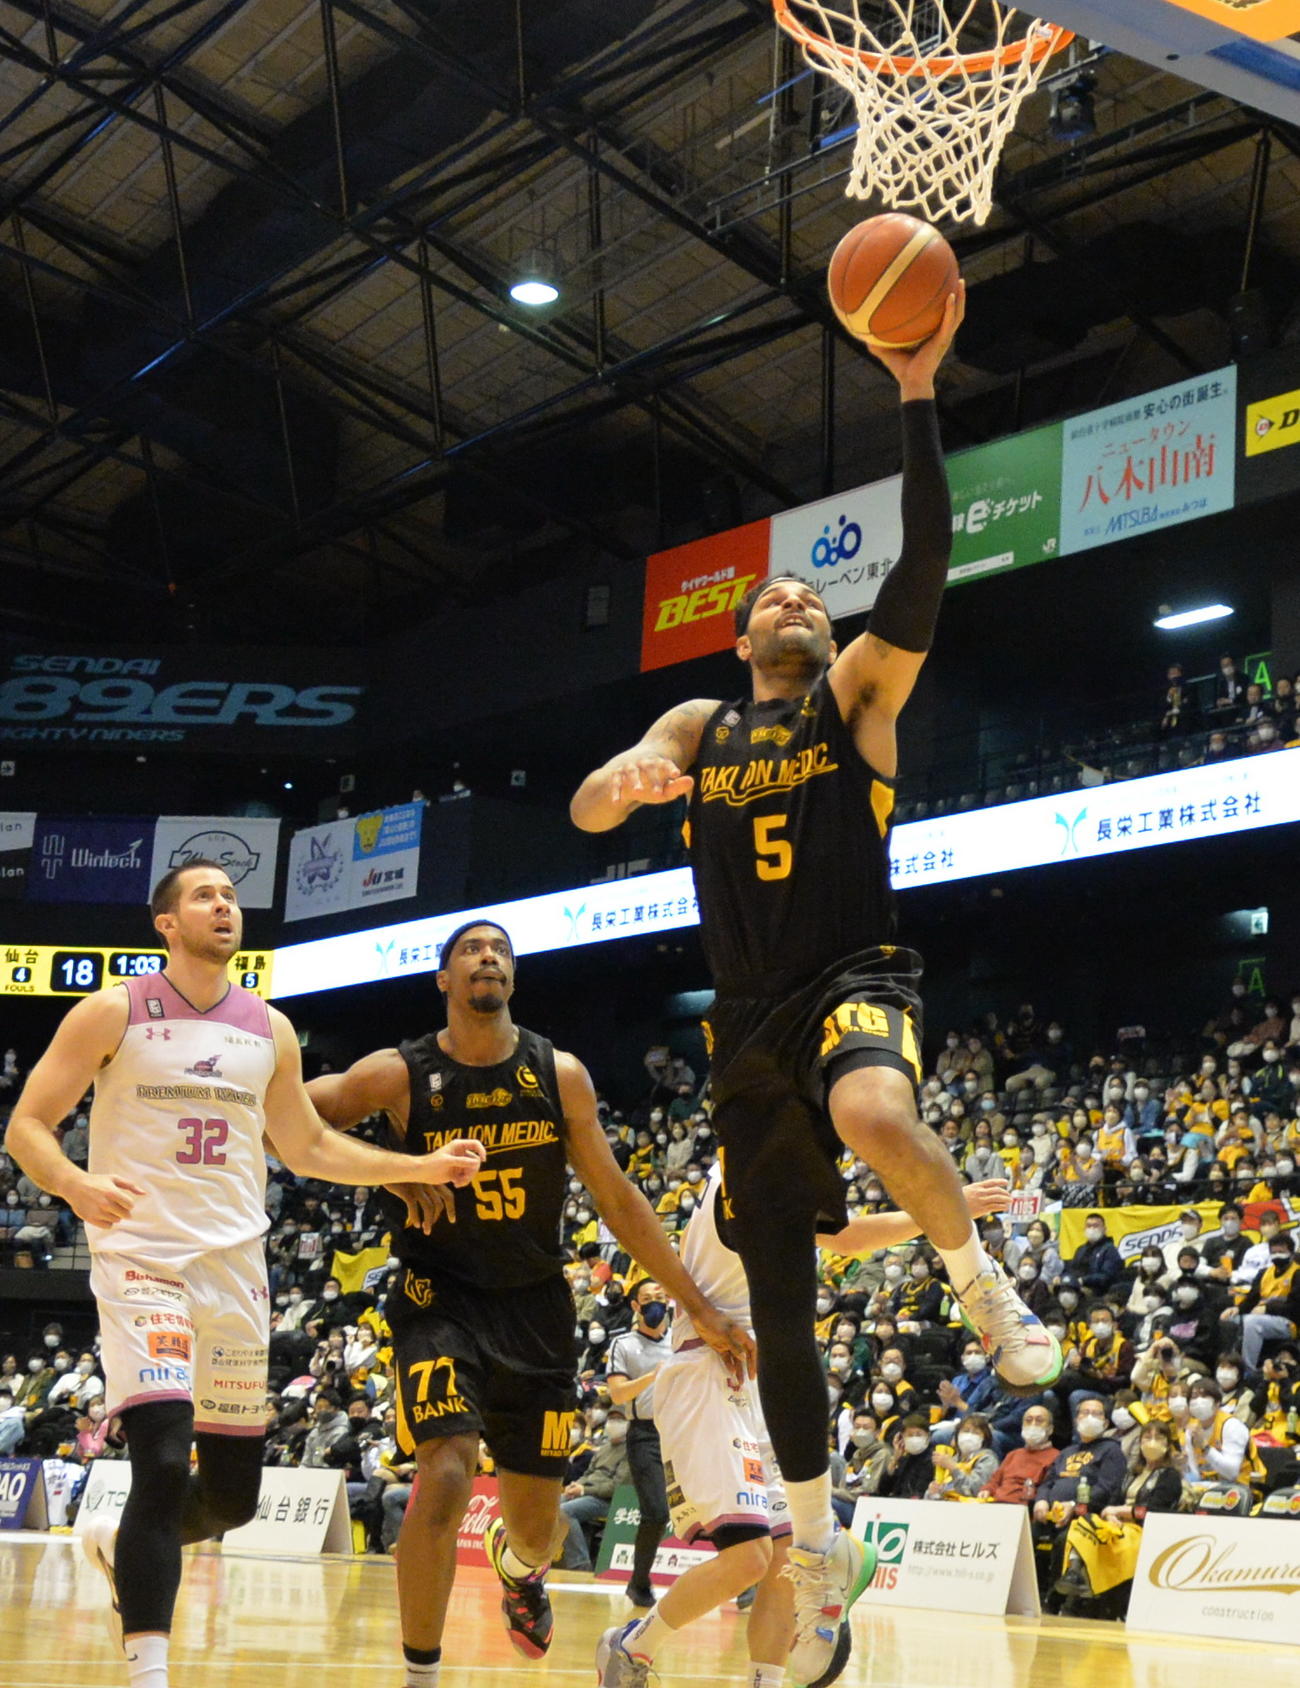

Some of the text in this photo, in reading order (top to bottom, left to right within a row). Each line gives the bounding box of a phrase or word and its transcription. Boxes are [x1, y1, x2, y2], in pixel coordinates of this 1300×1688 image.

[1103, 420, 1191, 458] ニュータウン
[1079, 434, 1216, 513] 八木山南
[653, 573, 757, 632] BEST
[10, 654, 162, 676] SENDAI
[0, 675, 365, 727] 89ERS
[1097, 790, 1261, 842] 長栄工業株式会社
[71, 848, 141, 869] Wintech
[753, 814, 793, 882] 5
[5, 948, 39, 965] 仙台
[116, 954, 162, 975] 1:03
[15, 967, 26, 982] 4
[61, 958, 94, 986] 18
[246, 973, 256, 987] 5
[4, 984, 36, 993] FOULS
[175, 1117, 229, 1165] 32
[500, 1119, 556, 1146] MEDIC
[471, 1166, 526, 1221] 55
[1122, 1224, 1184, 1252] SENDA
[408, 1355, 459, 1403] 77
[412, 1395, 469, 1424] BANK
[0, 1472, 27, 1502] AO
[257, 1494, 331, 1526] 仙台銀行
[1201, 1606, 1275, 1622] construction
